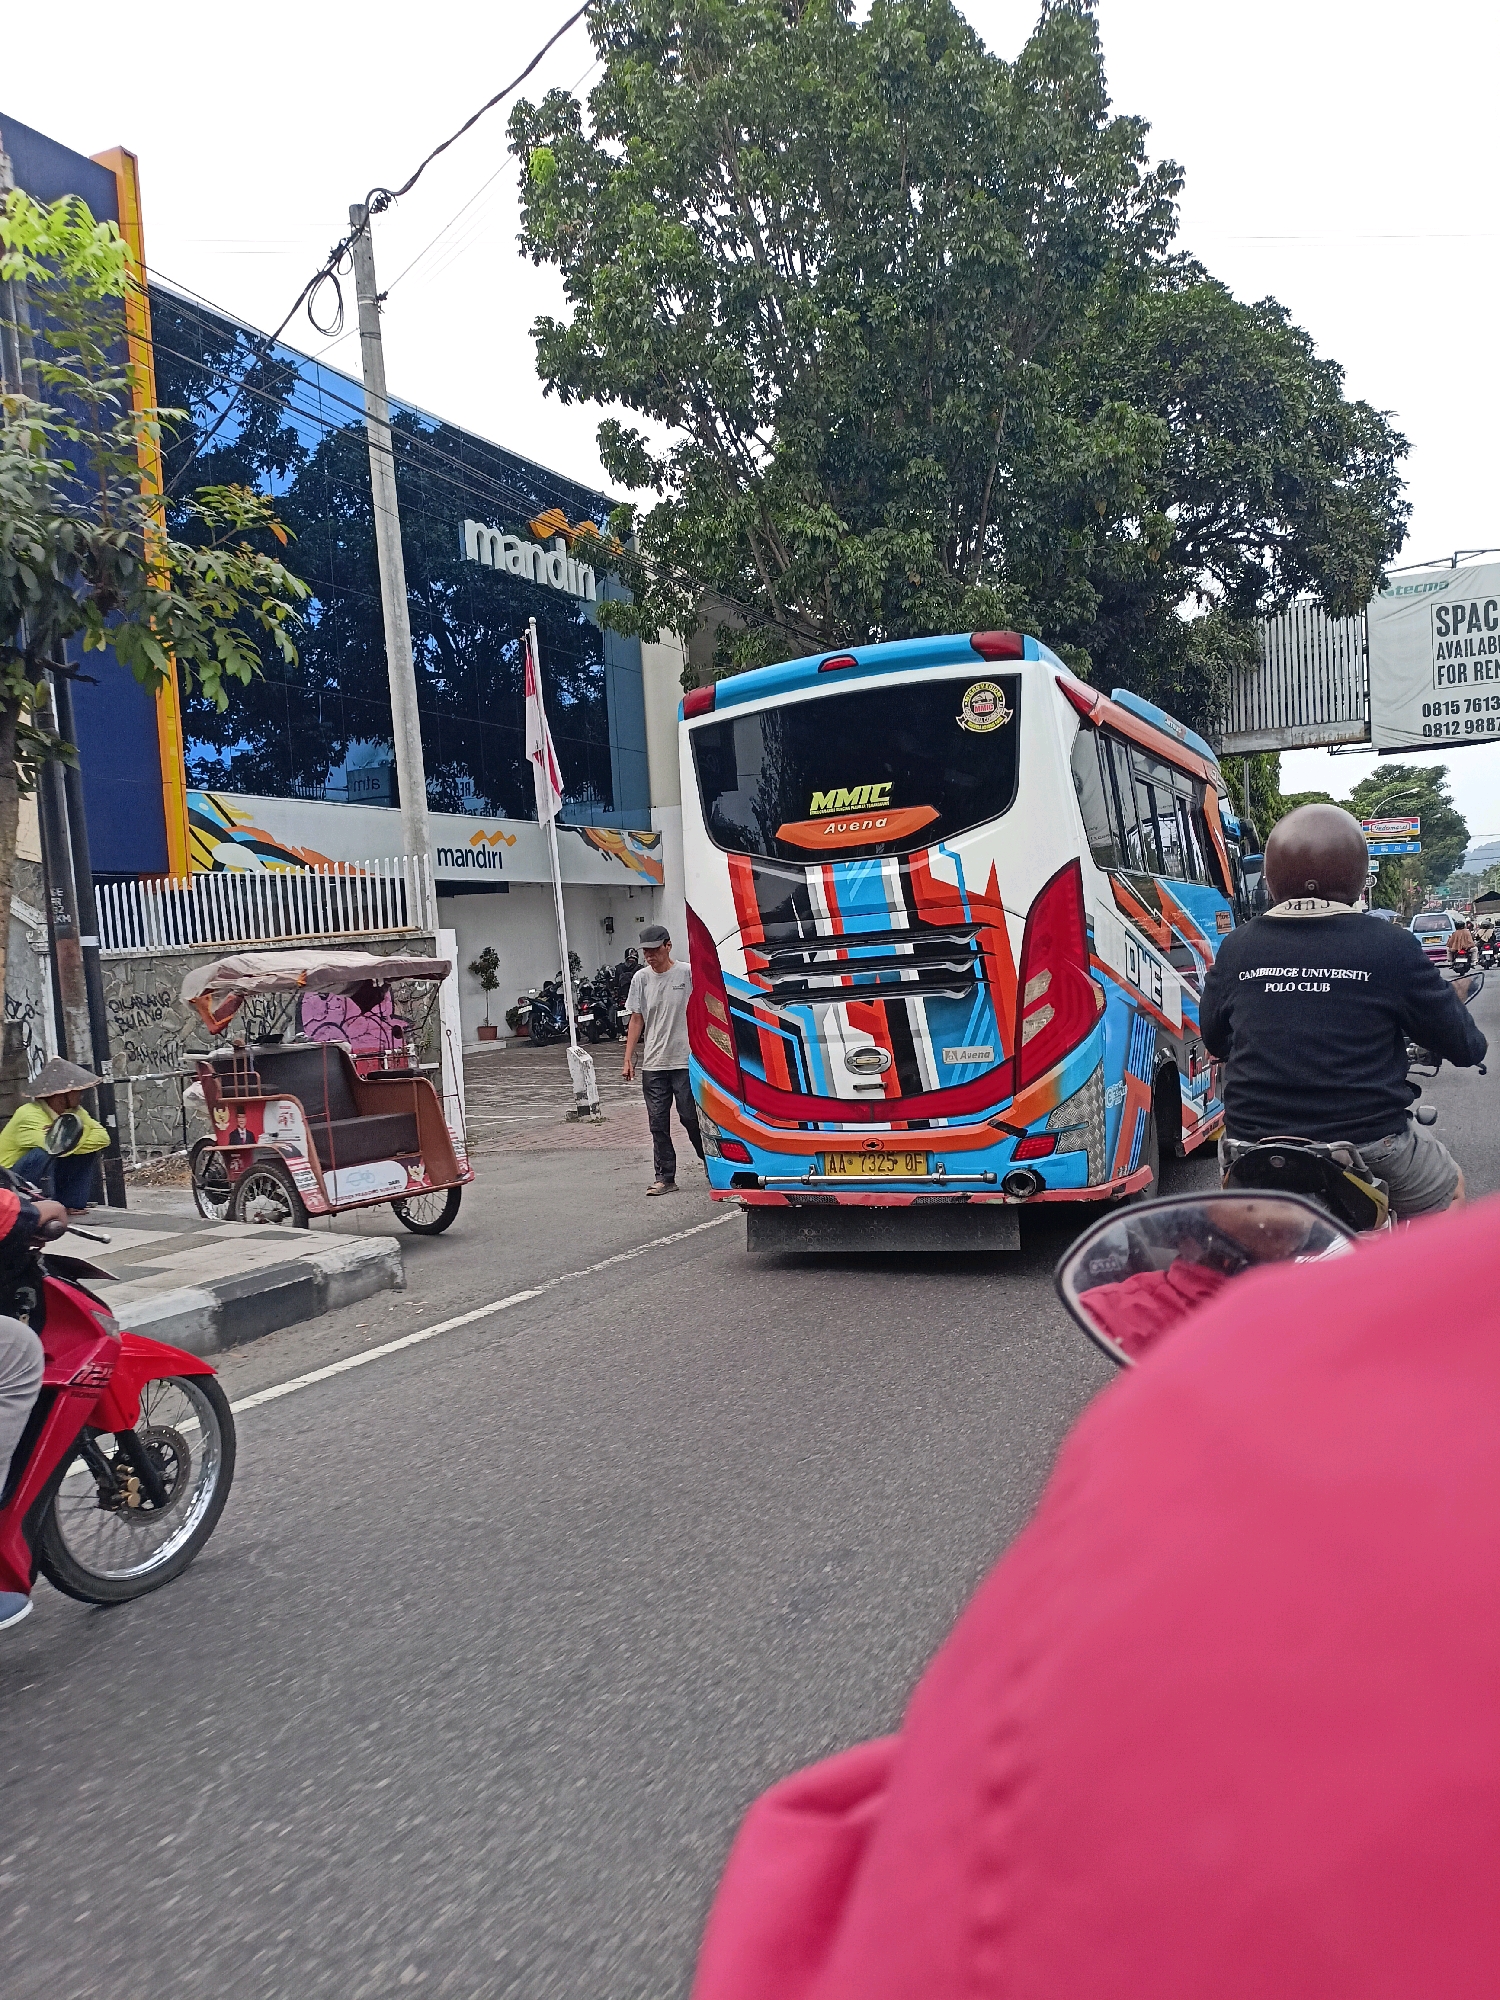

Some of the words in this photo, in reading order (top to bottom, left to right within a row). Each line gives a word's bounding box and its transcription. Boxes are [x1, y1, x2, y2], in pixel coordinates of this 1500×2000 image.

[1436, 634, 1500, 661] AVAILAB
[1437, 662, 1468, 685] FOR
[974, 704, 994, 714] MMIC
[1422, 700, 1460, 718] 0815
[1463, 695, 1500, 714] 7613
[1422, 720, 1461, 738] 0812
[809, 781, 893, 811] MMIC
[823, 817, 888, 835] Avena
[437, 843, 503, 870] mandiri
[1238, 967, 1299, 981] CAMBRIDGE
[1301, 967, 1372, 982] UNIVERSITY
[1264, 981, 1296, 993] POLO
[1297, 982, 1331, 993] CLUB
[959, 1050, 991, 1060] Avena
[829, 1153, 846, 1173] AA
[859, 1152, 898, 1172] 7325
